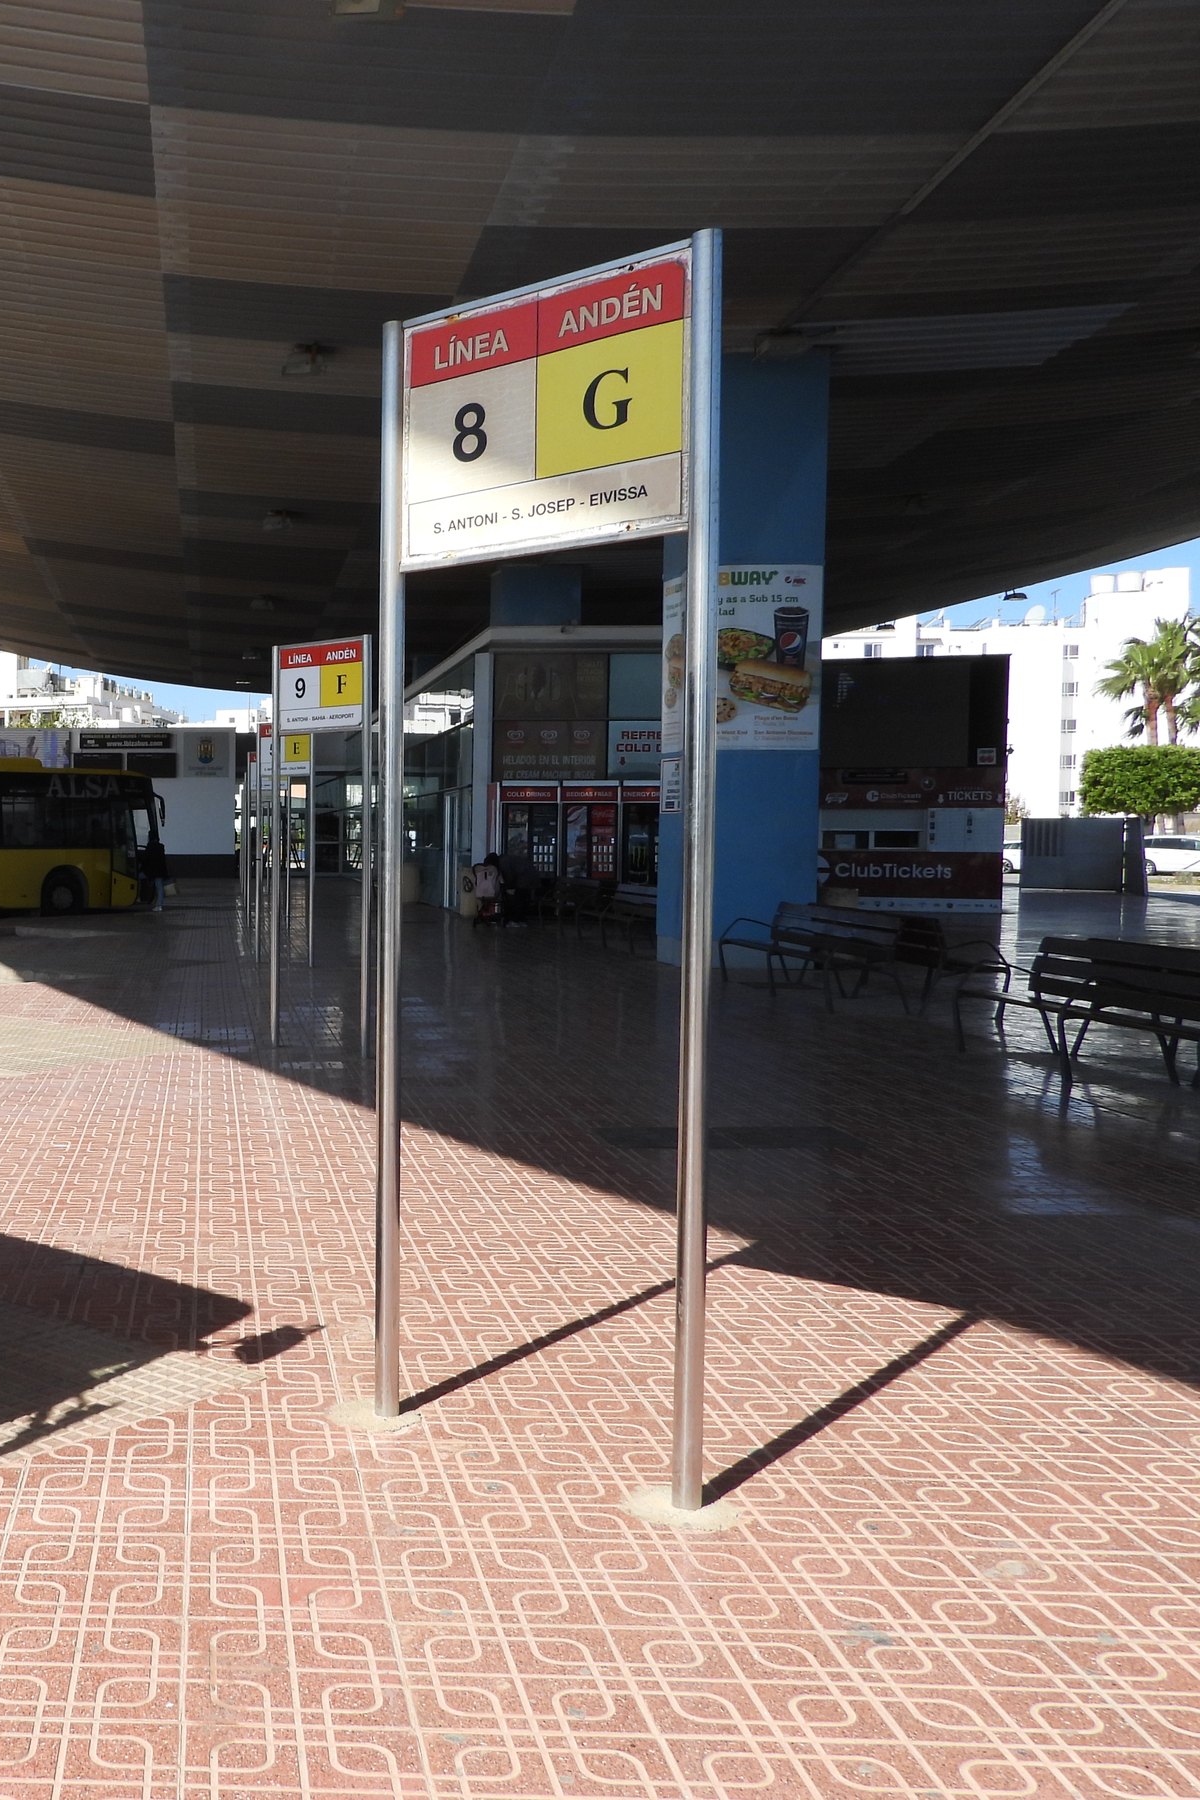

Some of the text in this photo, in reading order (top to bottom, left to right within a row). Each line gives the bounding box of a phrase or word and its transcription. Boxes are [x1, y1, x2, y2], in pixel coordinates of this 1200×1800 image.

[433, 284, 663, 370] LÍNEA ANDÉN
[452, 367, 633, 463] 8 G
[433, 521, 445, 534] S.
[448, 512, 498, 532] ANTONI
[511, 507, 524, 521] S.
[528, 498, 575, 518] JOSEP
[589, 484, 648, 507] EIVISSA
[726, 596, 738, 604] as
[749, 594, 768, 604] Sub
[771, 594, 782, 604] 15
[784, 596, 799, 604] cm
[288, 647, 356, 665] LÍNEA ANDÉN
[295, 674, 347, 699] 9 F
[329, 712, 355, 721] AEROPORT
[293, 742, 300, 755] E
[616, 743, 651, 752] COLD
[502, 754, 597, 766] HELADOS EN EL INTERIOR
[503, 769, 513, 779] ICE
[516, 769, 540, 779] CREAM
[46, 774, 120, 799] ALSA
[880, 790, 993, 800] ClubTickets TICKETS
[834, 861, 952, 880] ClubTickets
